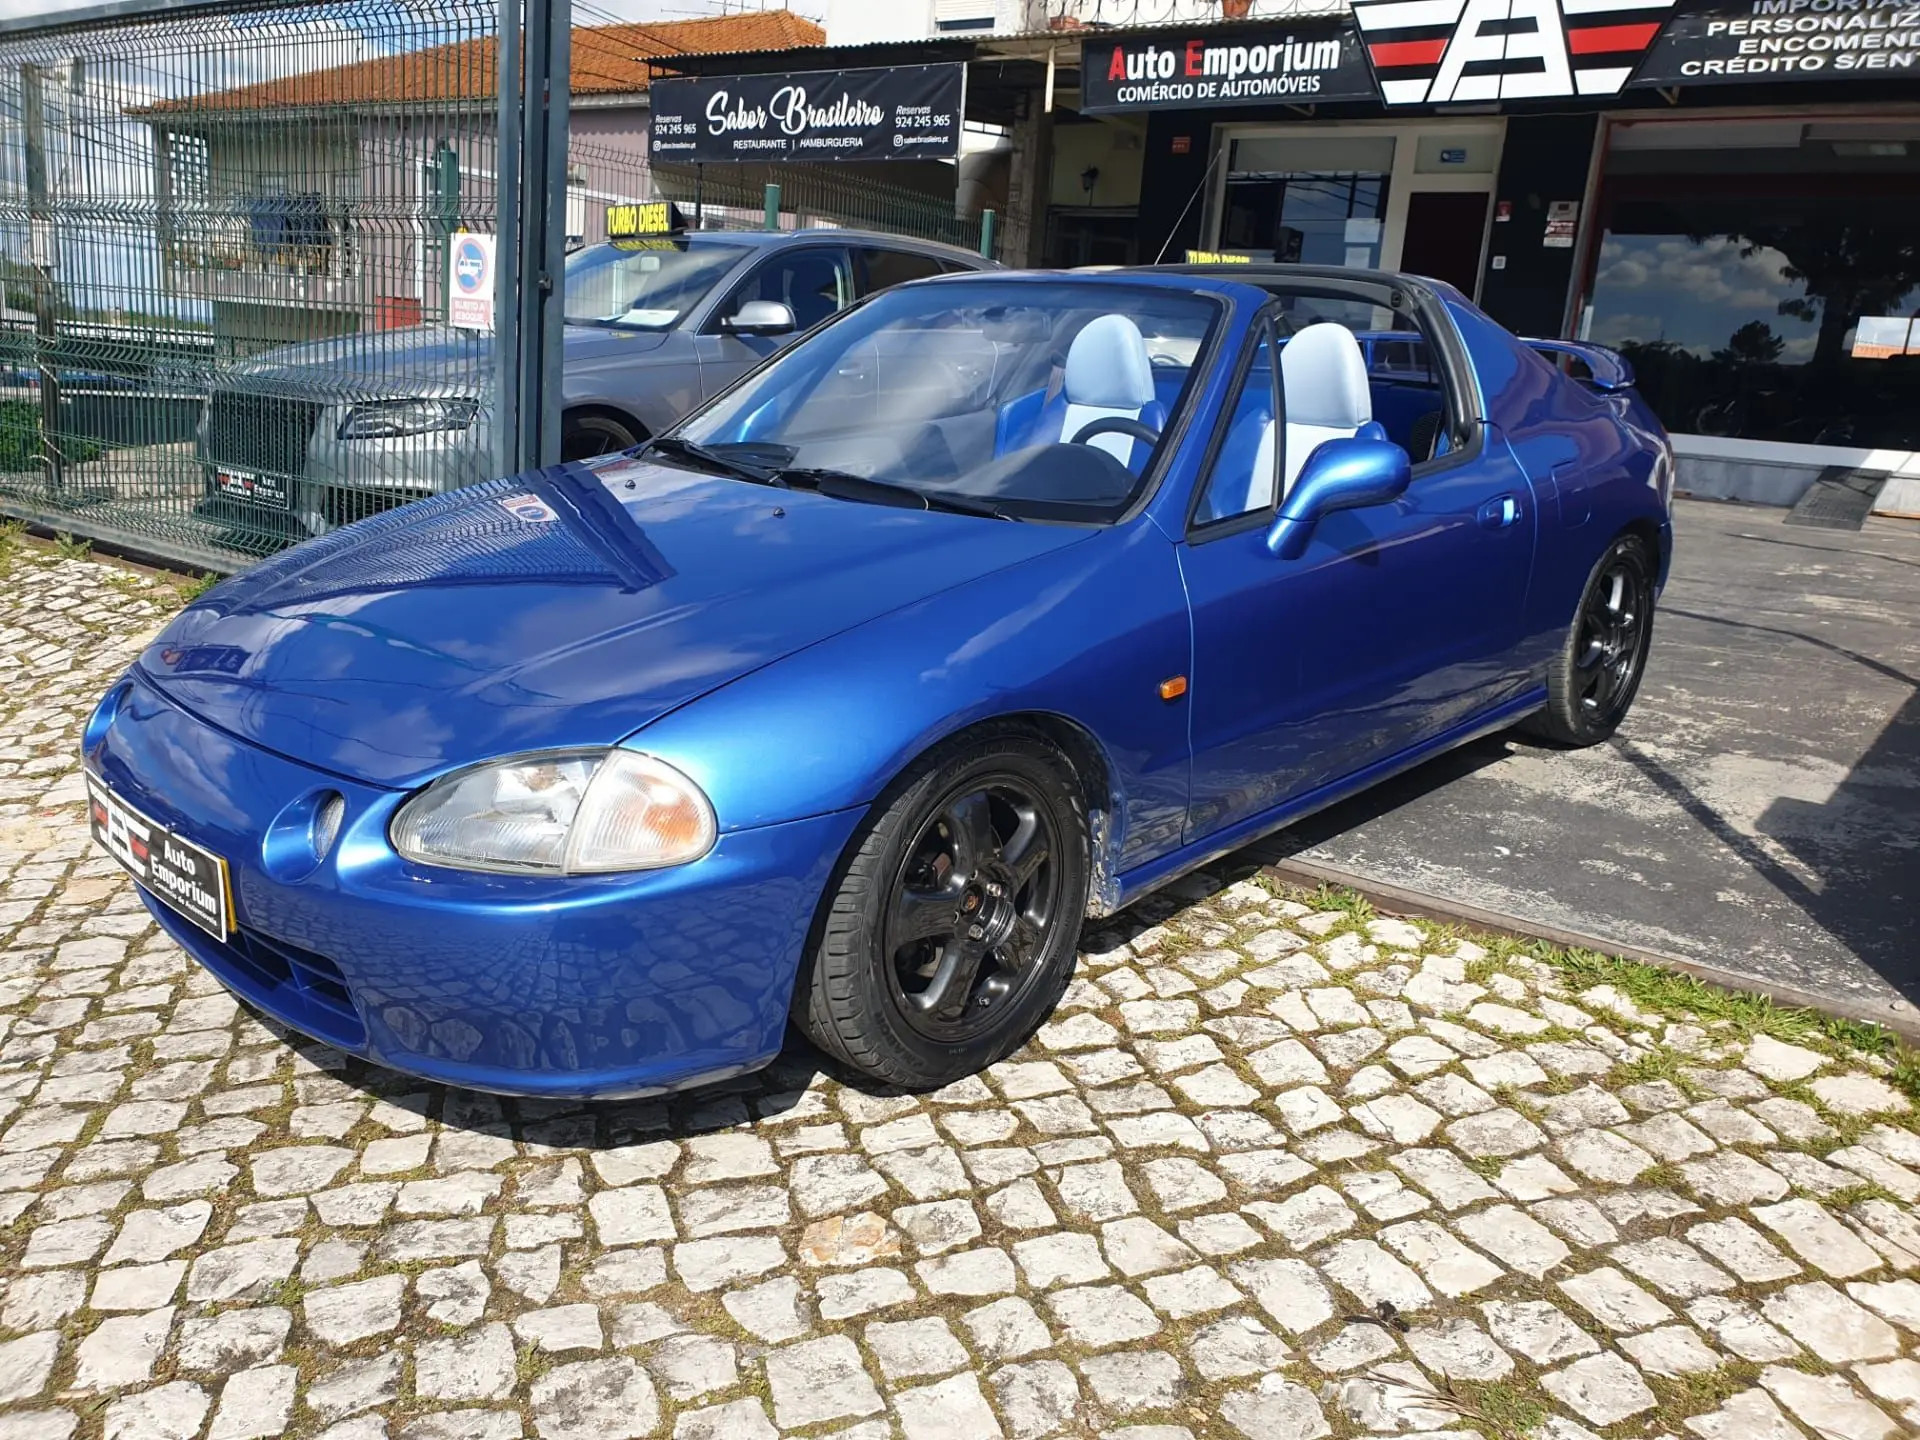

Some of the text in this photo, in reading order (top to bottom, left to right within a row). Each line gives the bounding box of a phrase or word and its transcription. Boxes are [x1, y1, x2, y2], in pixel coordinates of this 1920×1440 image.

[1108, 36, 1341, 81] Auto Emporium
[1680, 50, 1920, 76] CRÉDITO S/EN
[1117, 74, 1321, 103] COMÉRCIO DE AUTOMÓVEIS
[705, 86, 885, 136] Sabor Brasileiro
[895, 114, 951, 128] 924 245 965
[896, 105, 931, 115] Reservas
[655, 123, 697, 135] 924 245 965
[733, 139, 787, 150] RESTAURANTE
[799, 137, 864, 149] HAMBURGUERIA
[607, 203, 669, 234] TURBO DIESEL
[164, 840, 196, 875] Auto
[150, 854, 217, 914] Emporium
